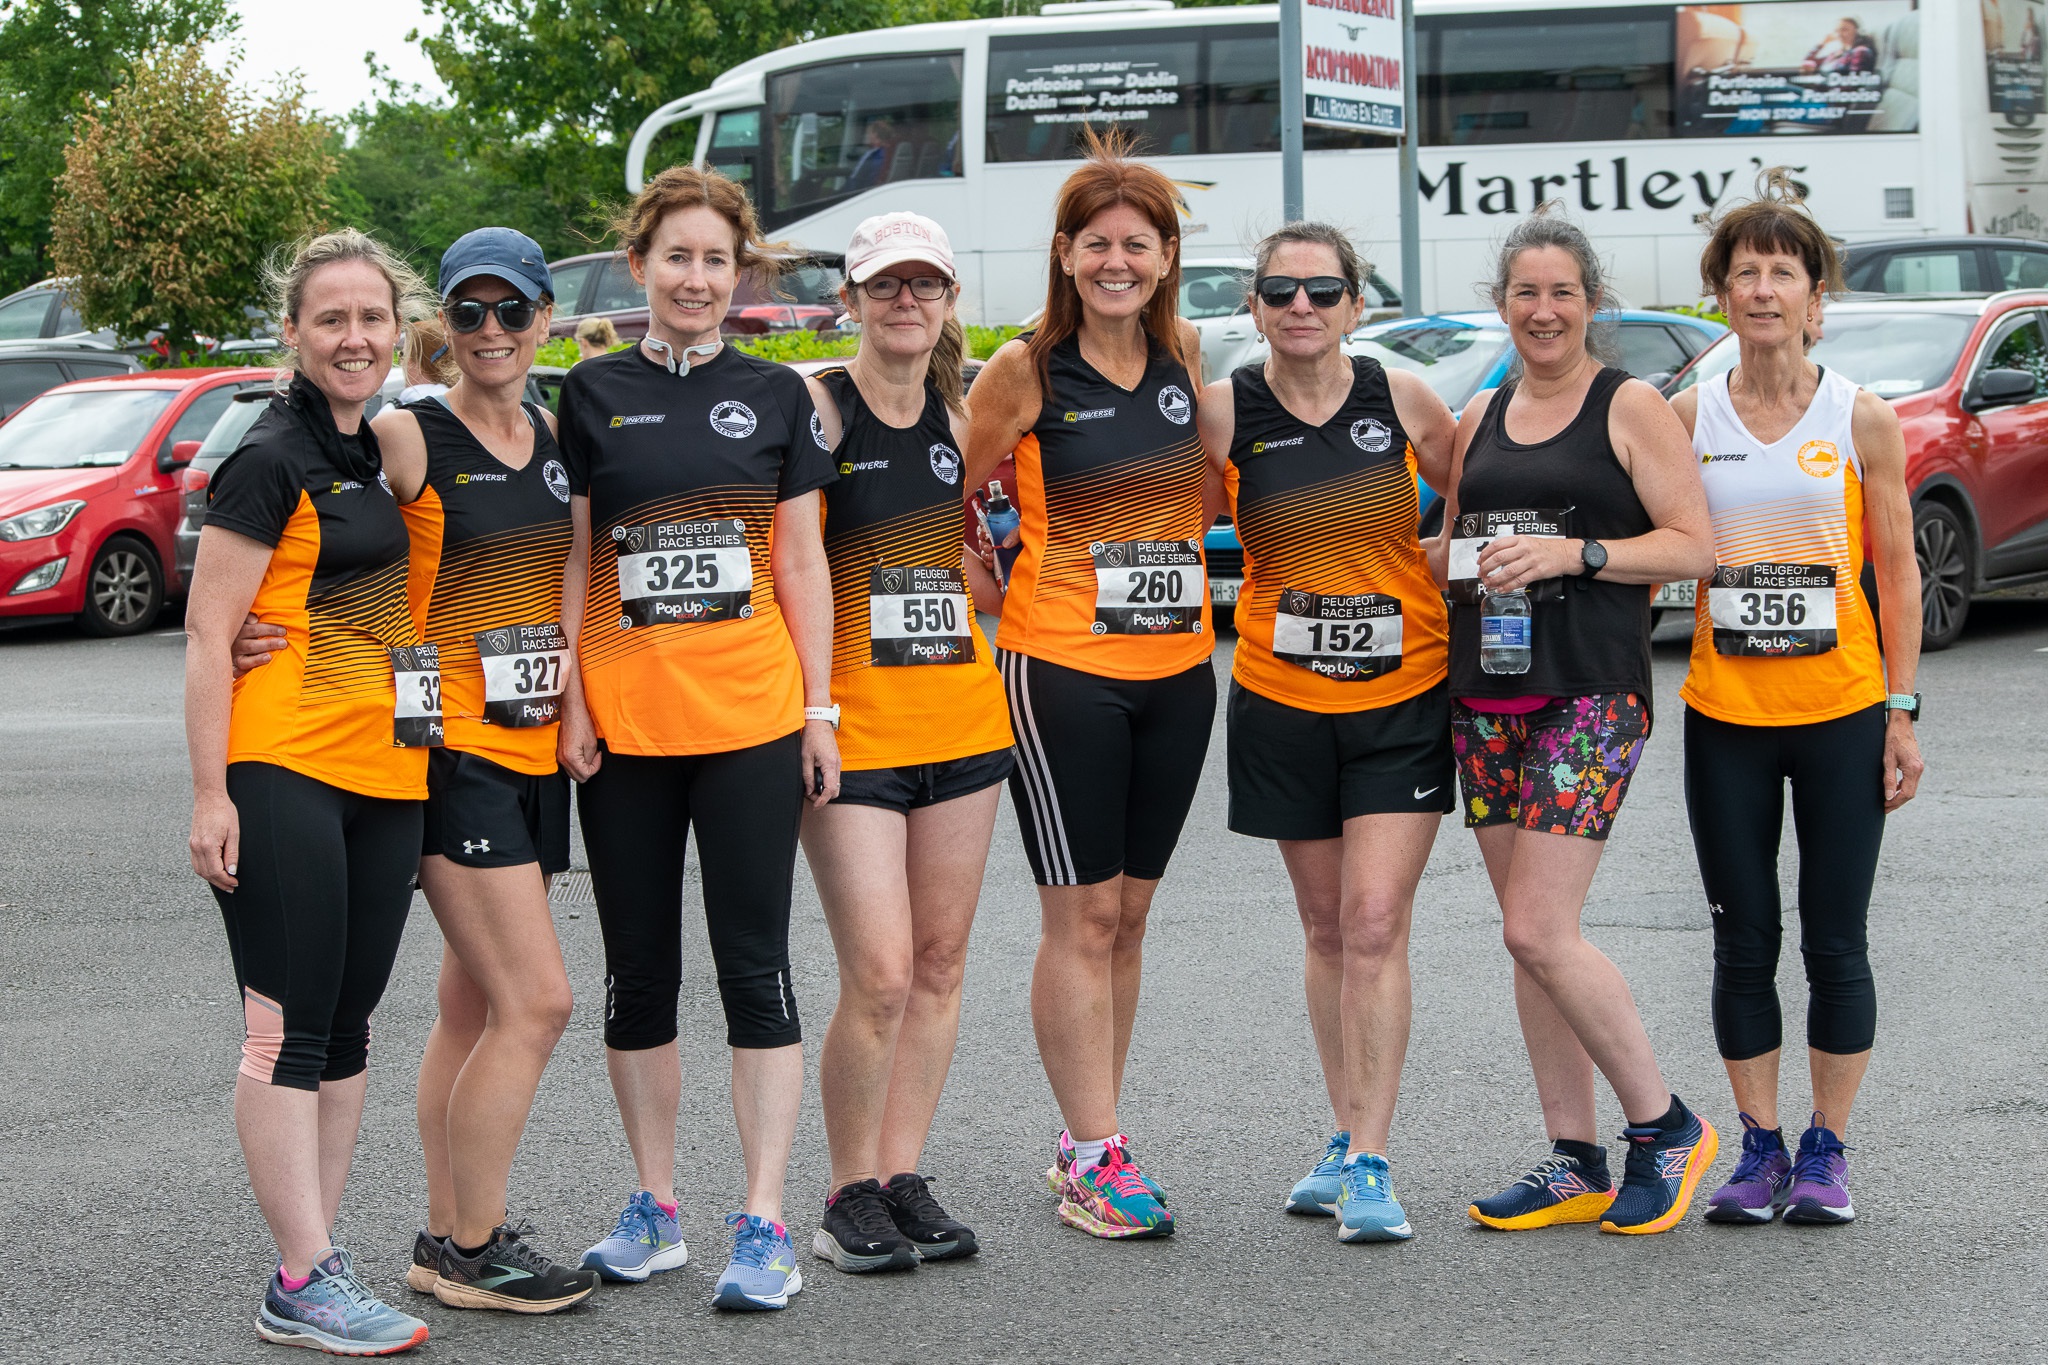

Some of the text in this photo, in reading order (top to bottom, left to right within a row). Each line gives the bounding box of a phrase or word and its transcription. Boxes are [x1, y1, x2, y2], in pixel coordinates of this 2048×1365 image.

[1052, 61, 1131, 74] NON STOP DAILY
[1306, 45, 1400, 91] ACCOMMODATION
[1005, 71, 1179, 94] Portlaoise Dublin
[1708, 71, 1881, 90] Portlaoise Dublin
[1005, 88, 1179, 111] Dublin Portlaoise
[1708, 87, 1881, 106] Dublin Portlaoise
[1313, 97, 1329, 118] ALL
[1330, 99, 1359, 121] ROOMS
[1372, 105, 1394, 125] SUITE
[1738, 106, 1846, 121] NON STOP DAILY
[874, 221, 932, 244] BOSTON
[712, 402, 755, 421] BRAY RUNNERS
[1079, 409, 1114, 420] INVERSE
[624, 415, 663, 425] INVERSE
[712, 418, 755, 438] ATHLETIC CLUB
[1265, 437, 1304, 449] INVERSE
[853, 460, 889, 472] INVERSE
[1711, 454, 1748, 463] INVERSE
[470, 473, 507, 483] INVERSE
[1488, 511, 1539, 523] PEUGEOT
[658, 523, 719, 536] PEUGEOT
[1517, 522, 1558, 533] SERIES
[659, 535, 741, 548] RACE SERIES
[1138, 543, 1180, 552] PEUGEOT
[1139, 553, 1197, 564] RACE SERIES
[646, 553, 719, 591] 325
[914, 569, 950, 579] PEUGEOT
[1754, 564, 1811, 575] PEUGEOT
[915, 581, 963, 592] RACE SERIES
[1127, 569, 1182, 604] 260
[1753, 576, 1829, 587] RACE SERIES
[1322, 595, 1376, 607] PEUGEOT
[656, 601, 703, 617] Pop Up
[903, 598, 956, 632] 550
[1321, 604, 1395, 618] RACE SERIES
[1740, 592, 1806, 626] 356
[1134, 613, 1170, 628] Pop Up
[521, 625, 558, 638] PEUGEOT
[1308, 622, 1374, 652] 152
[522, 639, 547, 650] RACE
[912, 643, 949, 658] Pop Up
[1748, 635, 1790, 651] Pop Up
[514, 656, 560, 693] 327
[1312, 660, 1355, 676] Pop Up
[524, 704, 543, 720] Pop
[543, 704, 553, 718] Up
